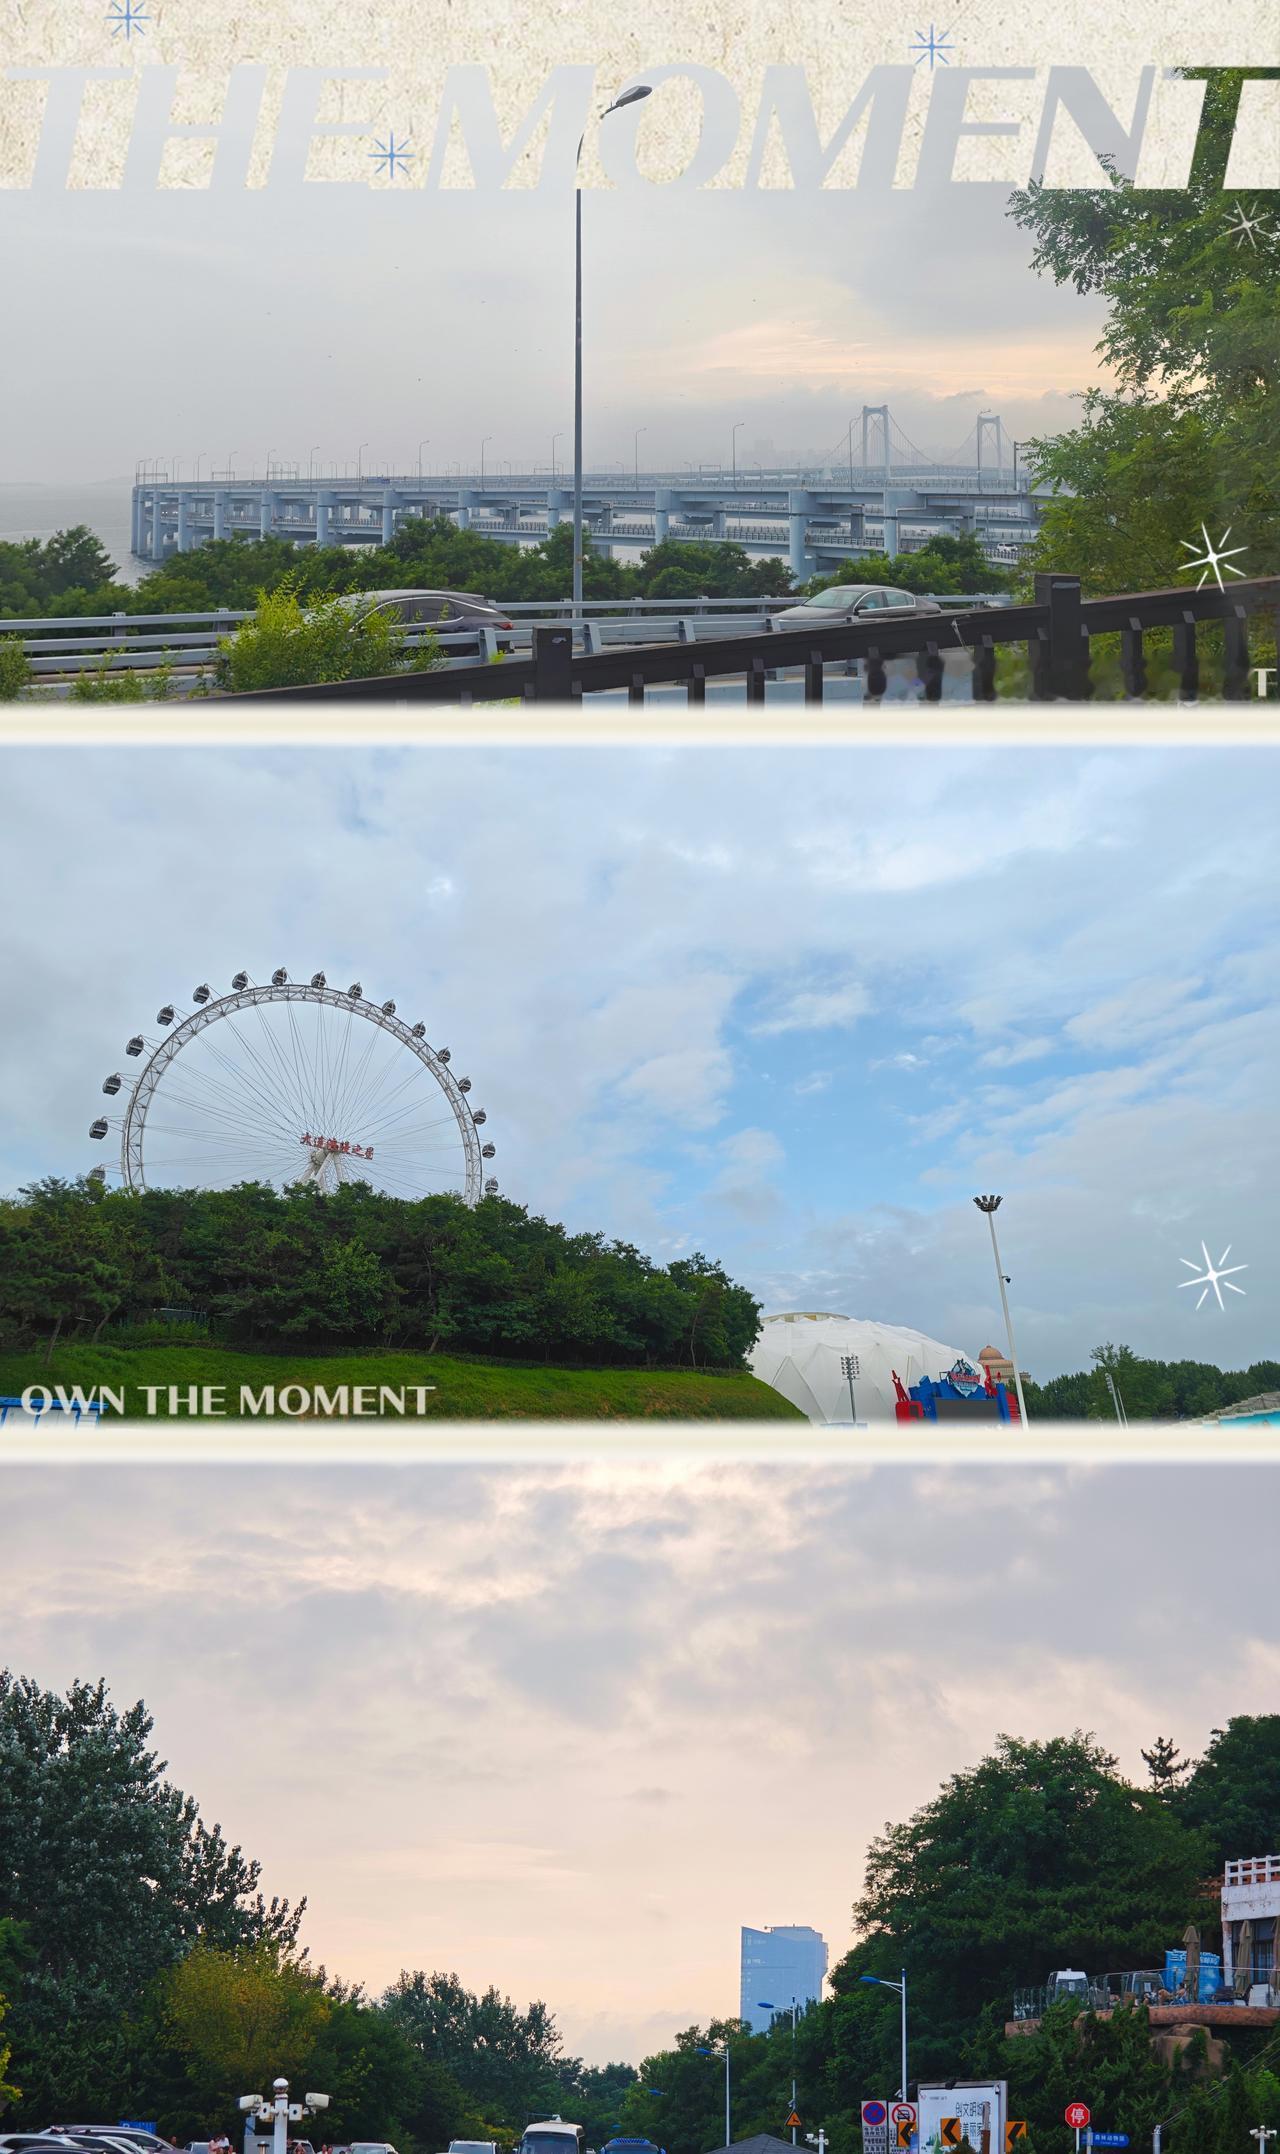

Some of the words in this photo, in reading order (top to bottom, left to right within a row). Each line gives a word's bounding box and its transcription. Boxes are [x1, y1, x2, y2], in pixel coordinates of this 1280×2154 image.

[955, 2101, 991, 2118] 创文明城
[1070, 2107, 1085, 2124] 停
